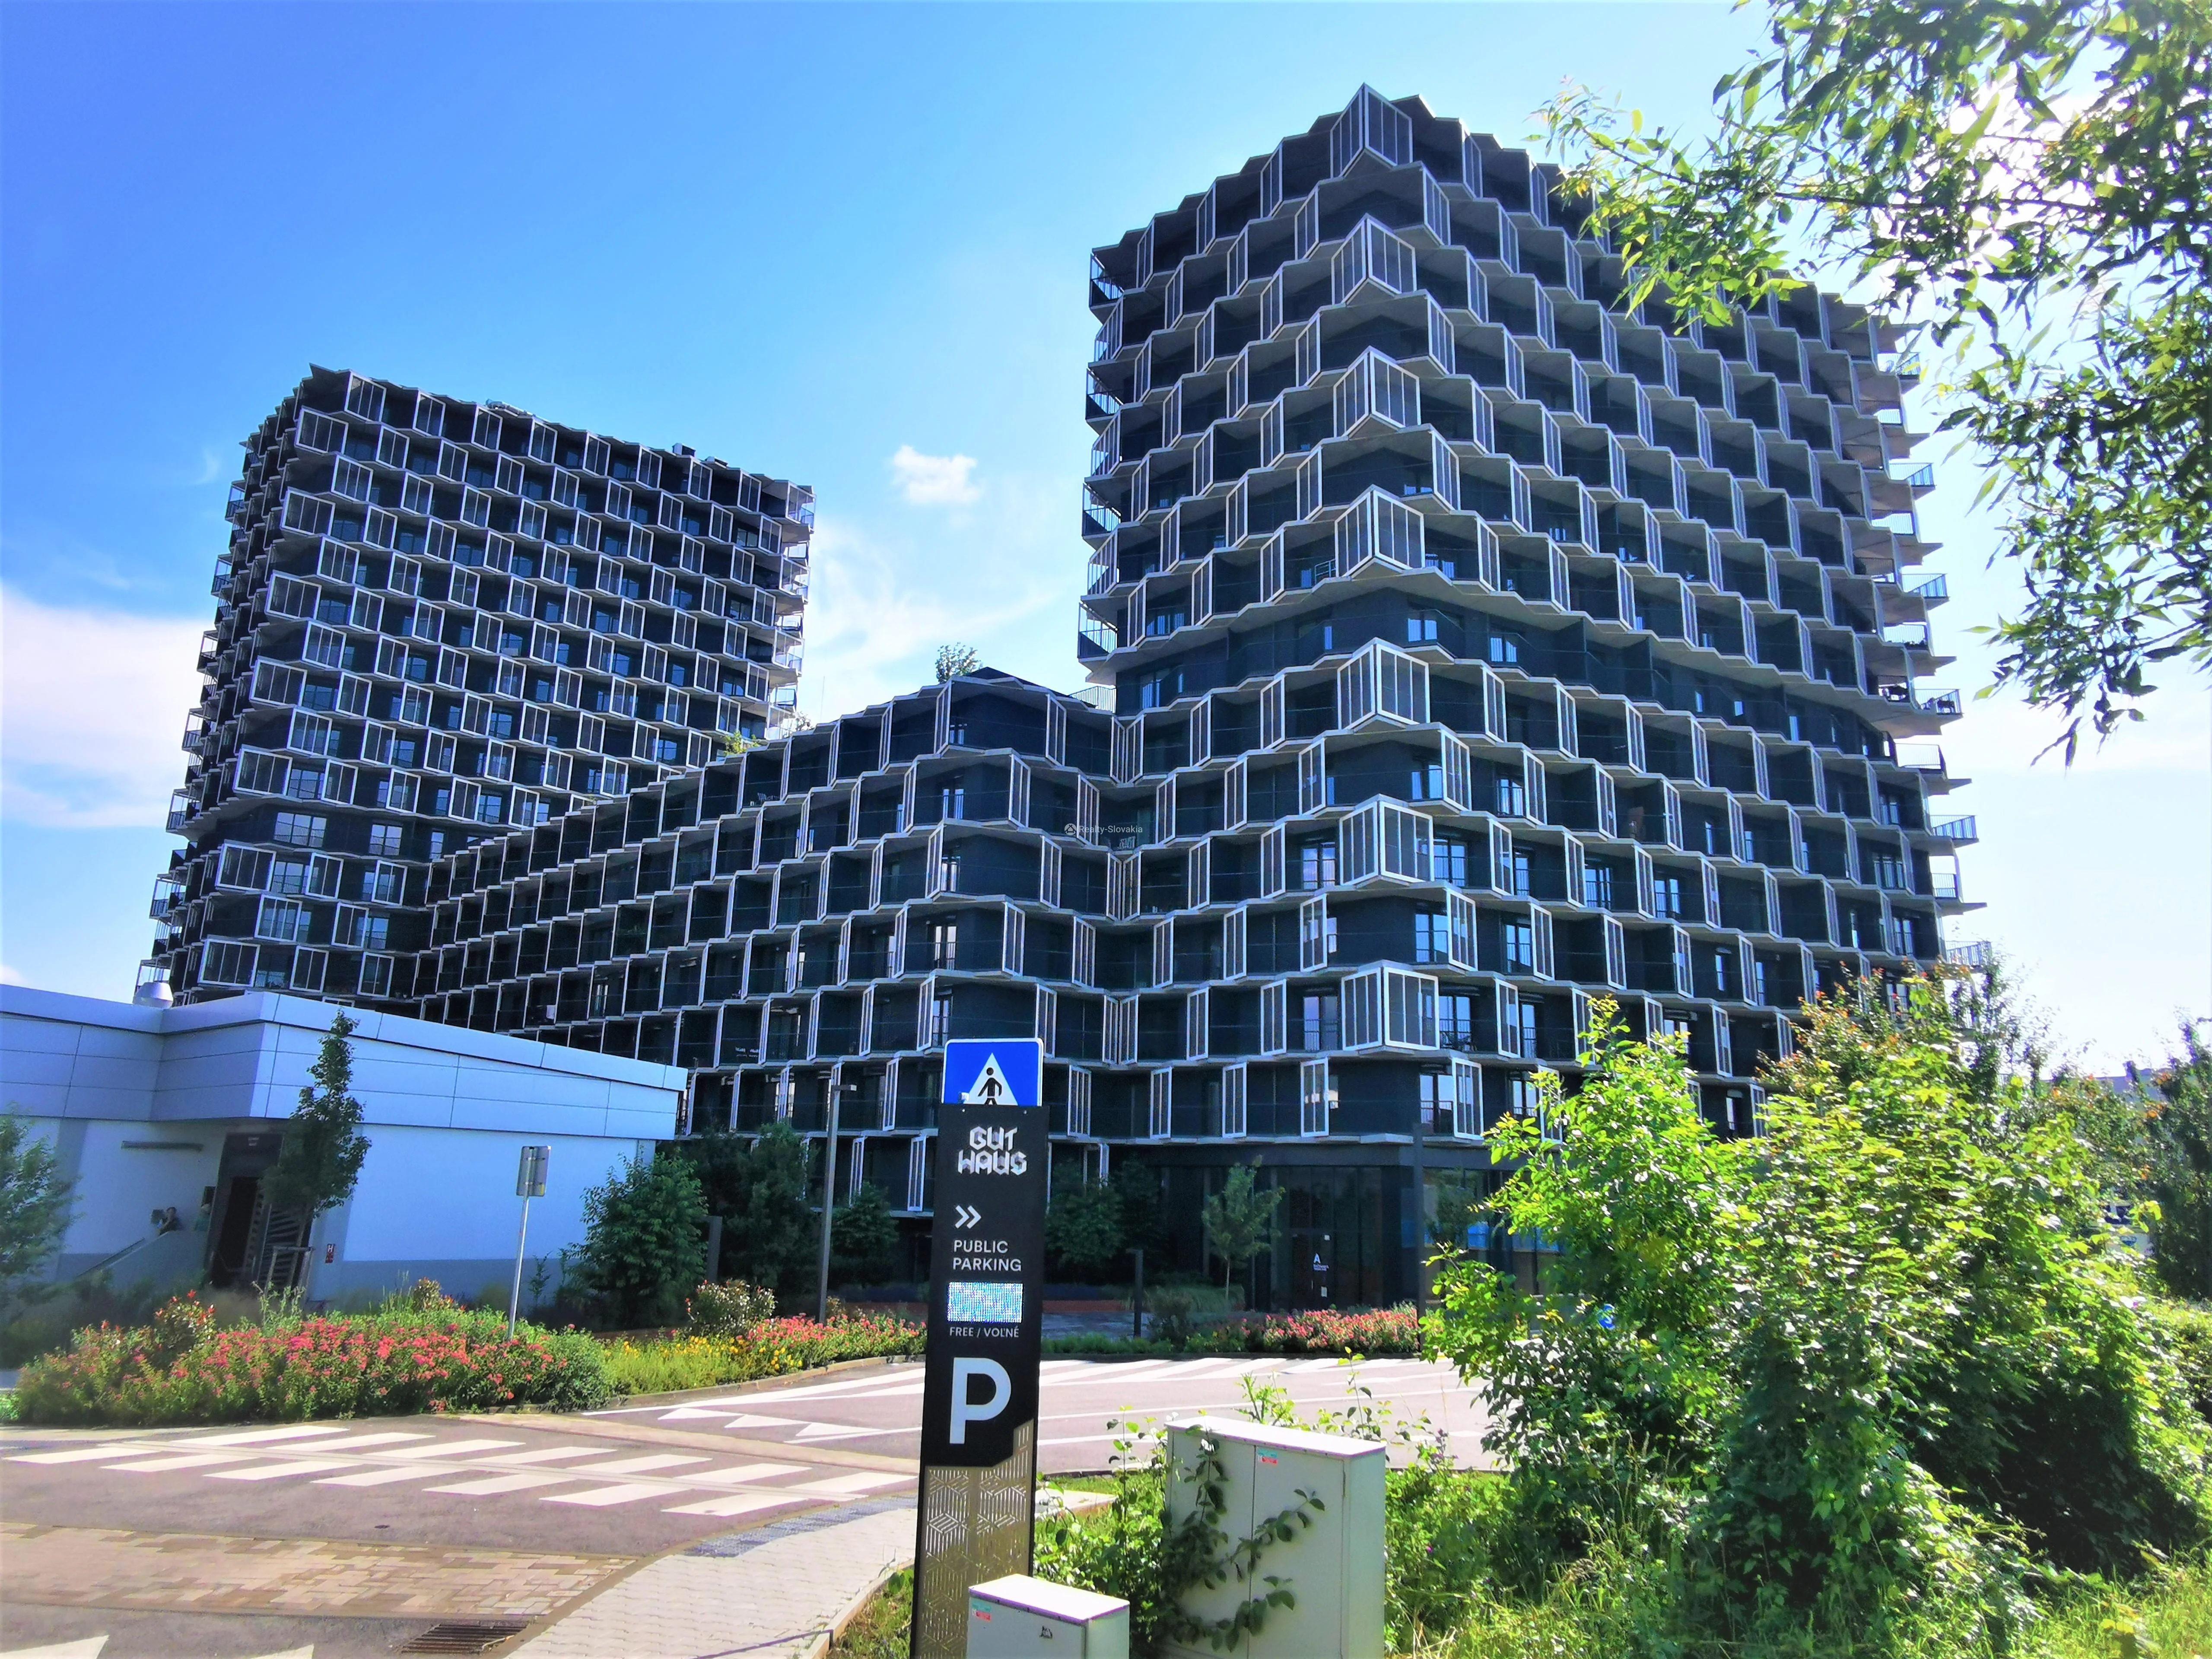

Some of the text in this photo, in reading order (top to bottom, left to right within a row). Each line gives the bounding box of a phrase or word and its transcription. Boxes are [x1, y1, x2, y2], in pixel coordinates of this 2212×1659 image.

[969, 1126, 1017, 1150] GUT
[958, 1150, 1027, 1175] HAUS
[953, 1239, 1008, 1253] PUBLIC
[953, 1258, 1021, 1271] PARKING
[949, 1327, 974, 1337] FREE
[984, 1325, 1019, 1338] VOĽNÉ
[950, 1357, 1011, 1444] P
